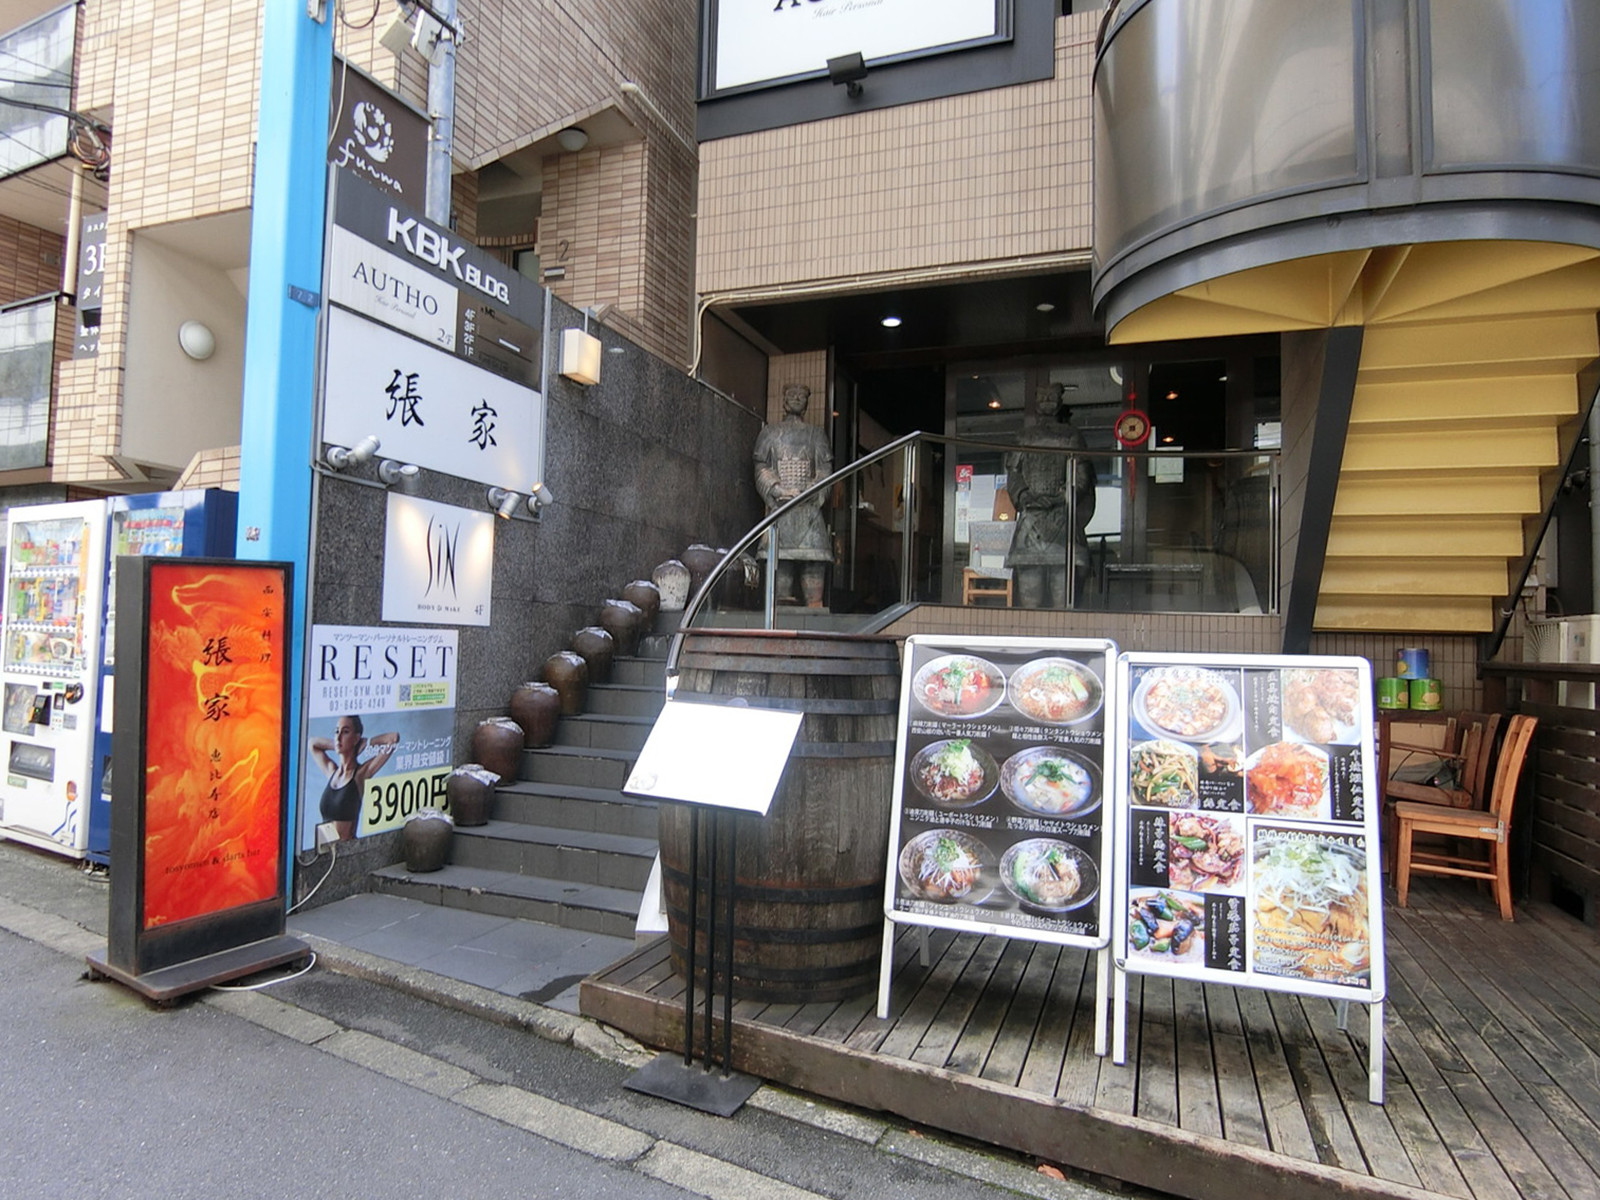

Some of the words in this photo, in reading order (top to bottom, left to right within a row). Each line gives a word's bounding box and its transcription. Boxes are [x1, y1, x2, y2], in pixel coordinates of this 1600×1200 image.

[387, 206, 465, 281] KBK
[352, 261, 438, 315] AUTHO
[464, 320, 475, 333] 3F
[465, 308, 476, 321] 4F
[463, 332, 475, 345] 2F
[464, 344, 474, 357] 1F
[202, 636, 233, 722] 張家
[317, 644, 453, 682] RESET
[368, 772, 450, 826] 3900円
